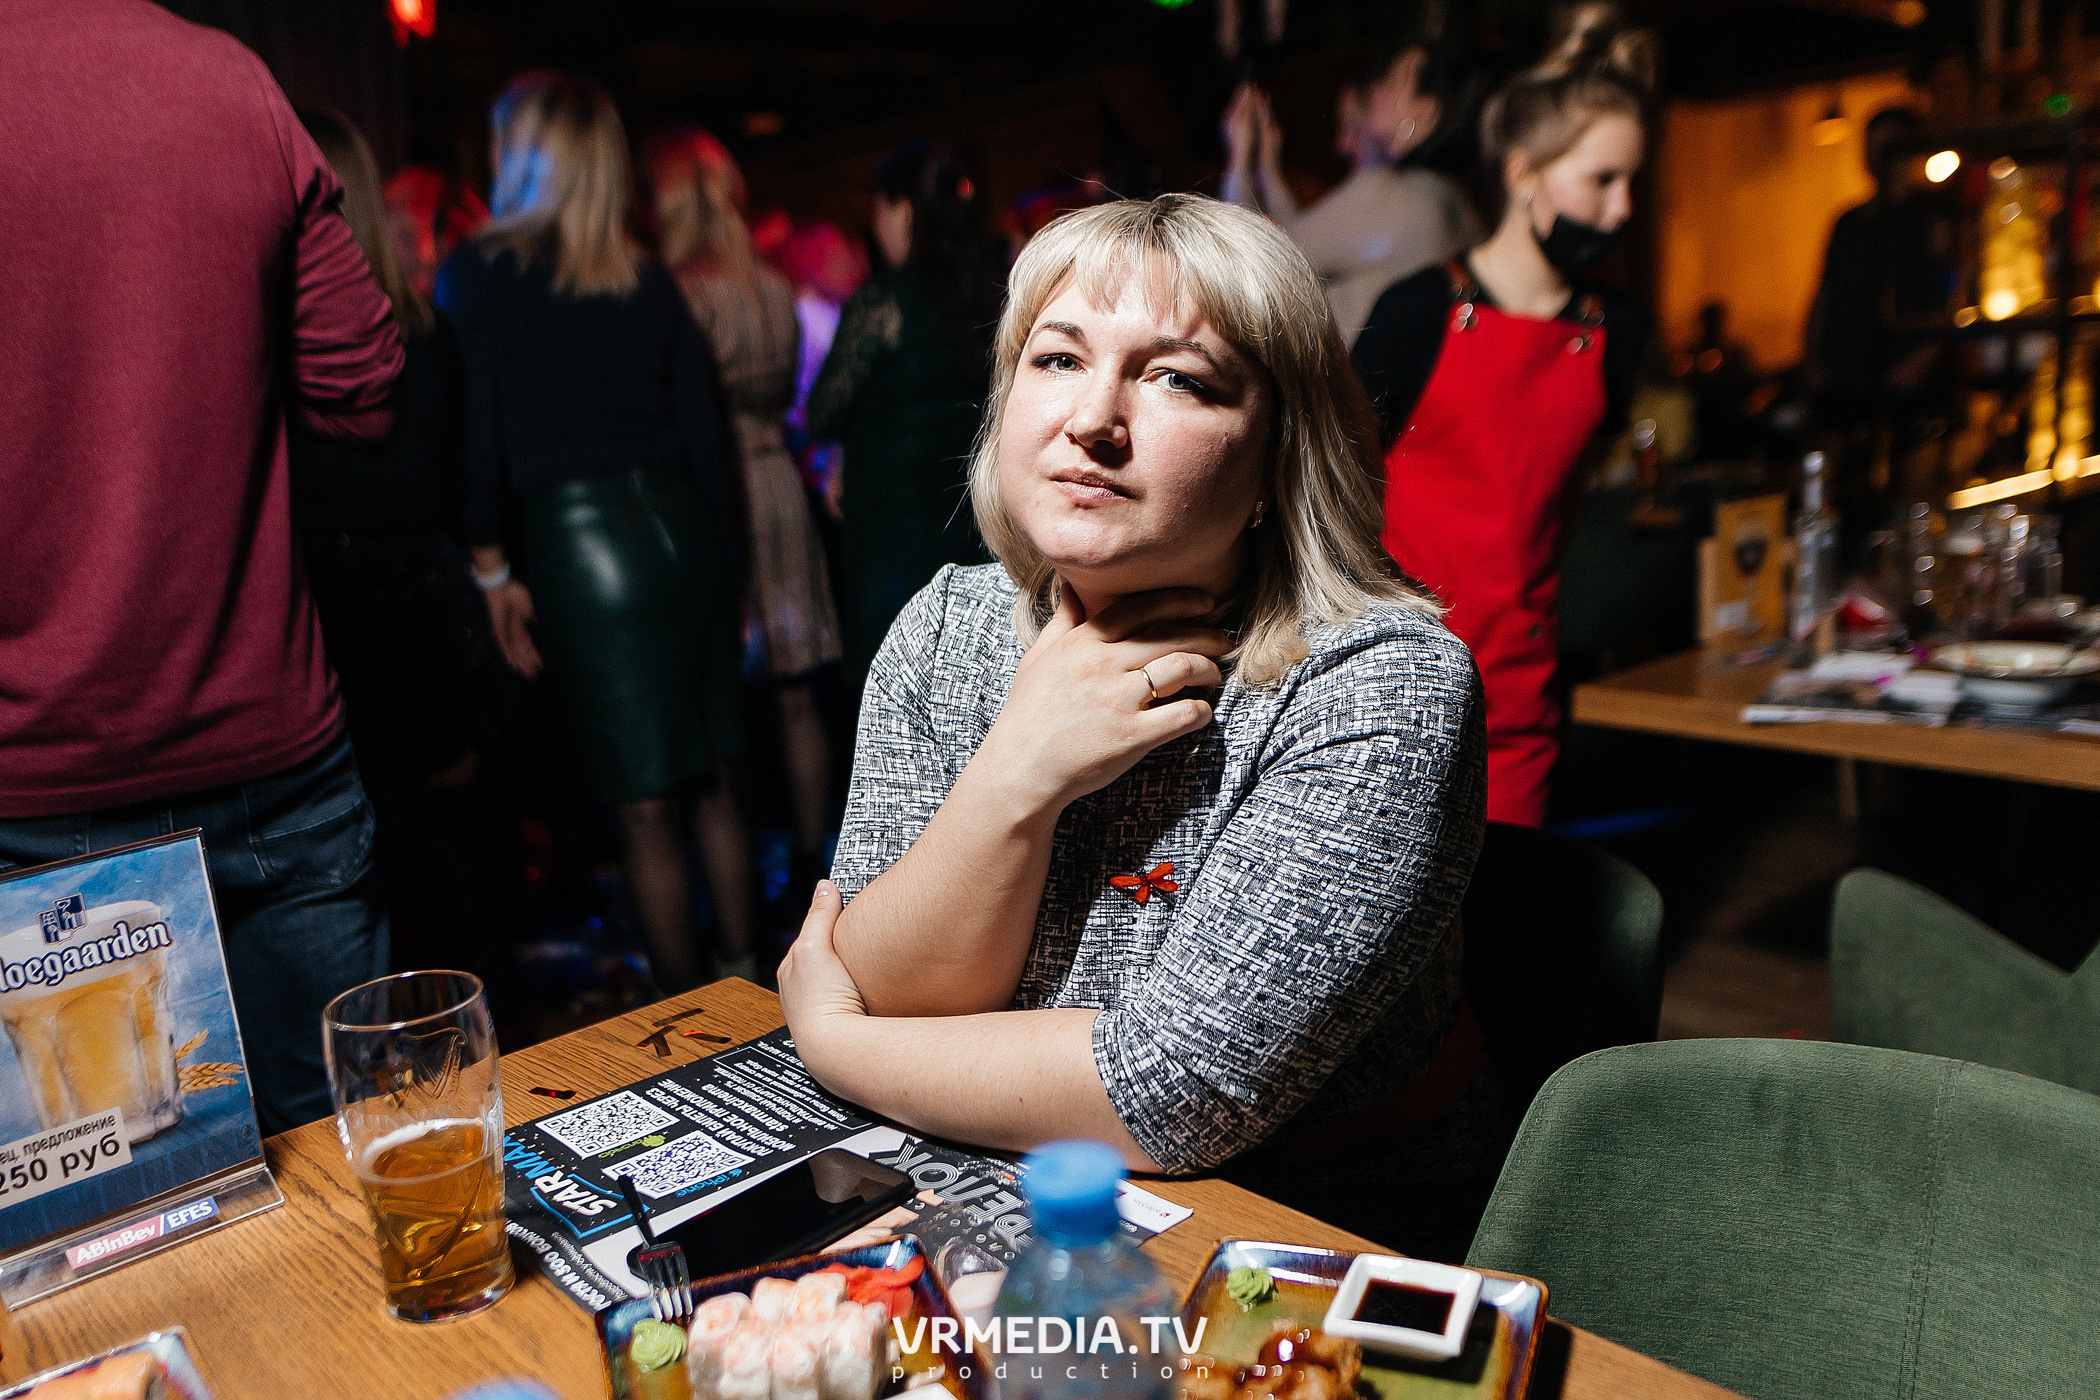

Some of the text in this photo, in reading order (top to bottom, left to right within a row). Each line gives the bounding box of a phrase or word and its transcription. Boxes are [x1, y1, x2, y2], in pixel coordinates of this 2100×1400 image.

[642, 1086, 774, 1157] ПОКУПАЙ БИЛЕТЫ ЧЕРЕЗ
[655, 1077, 796, 1152] МОБИЛЬНОЕ ПРИЛОЖЕНИЕ
[699, 1082, 789, 1133] starmaxcinema
[23, 1114, 116, 1158] предложение
[60, 1131, 120, 1179] руб
[675, 1174, 730, 1198] iPhone
[166, 1200, 214, 1230] EFES
